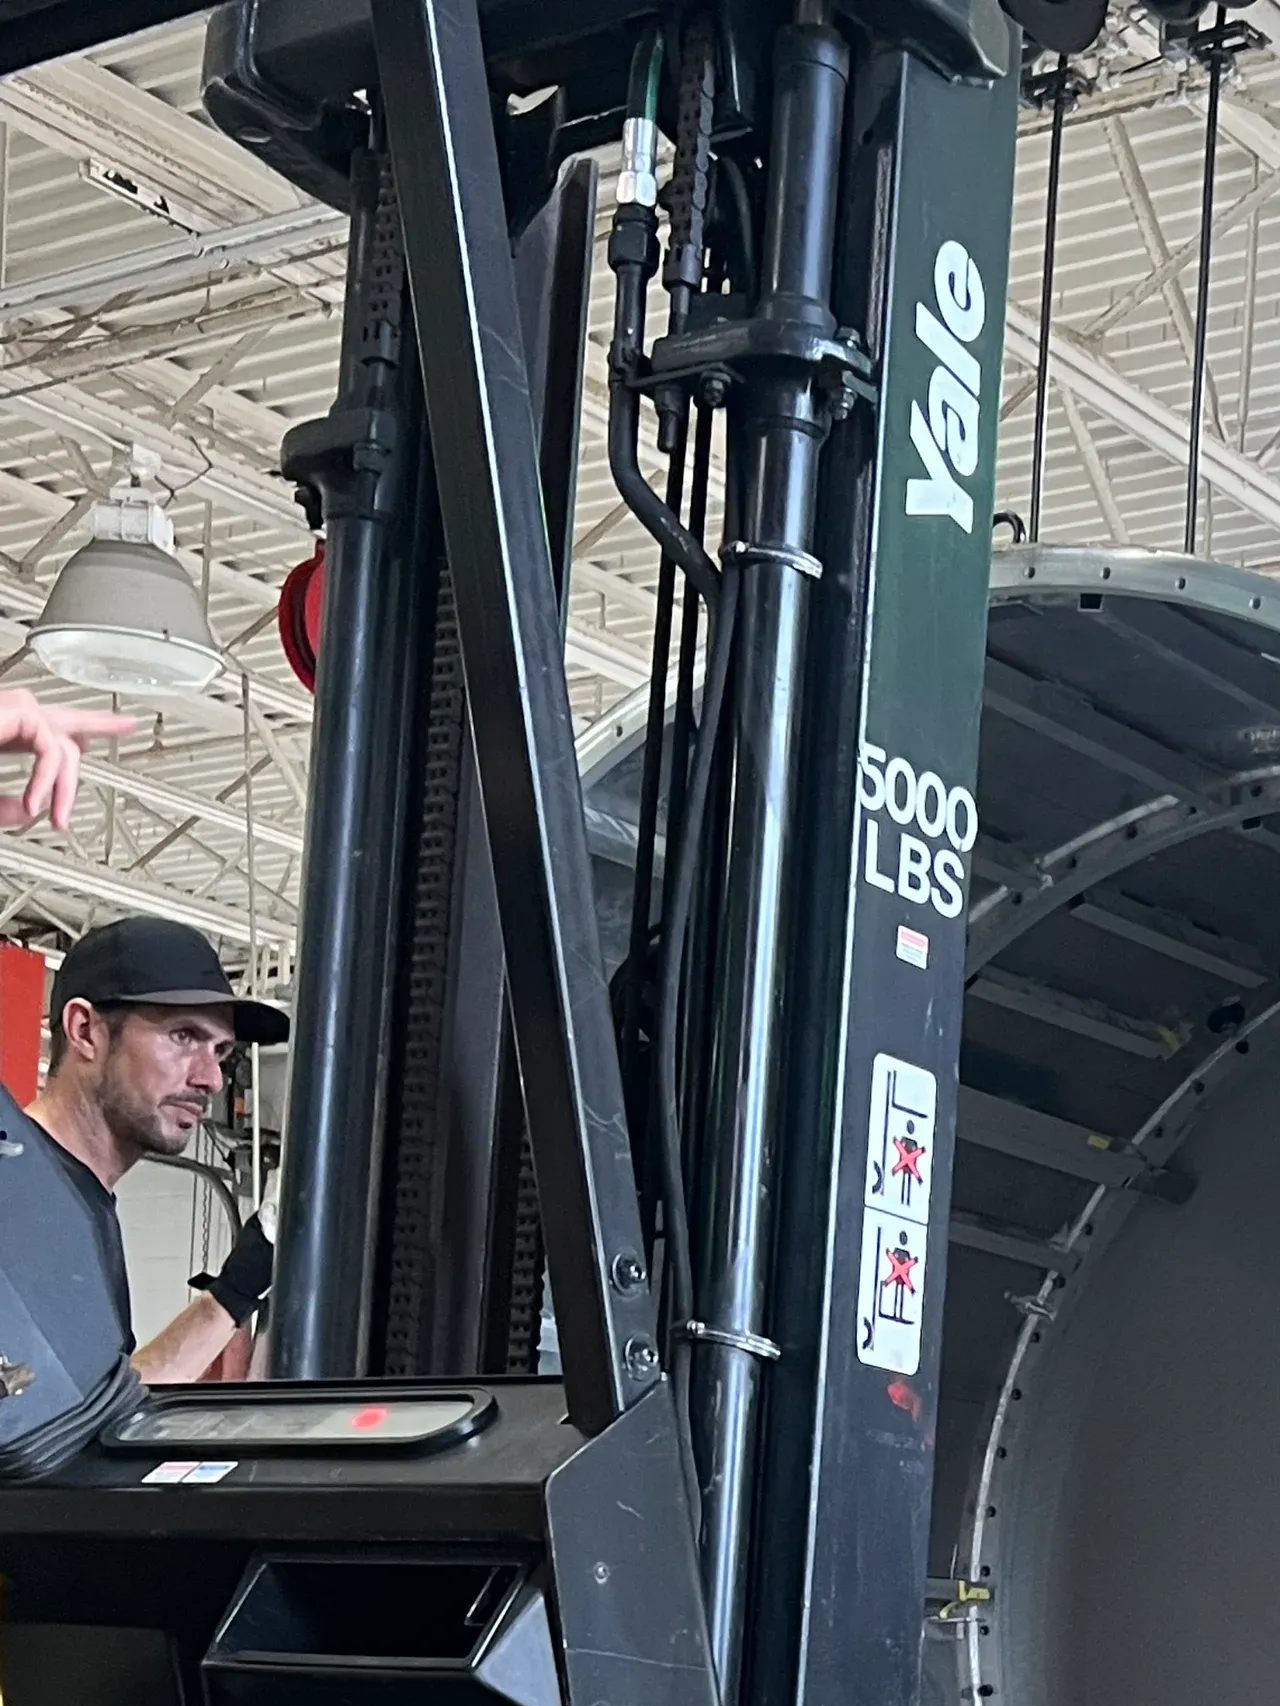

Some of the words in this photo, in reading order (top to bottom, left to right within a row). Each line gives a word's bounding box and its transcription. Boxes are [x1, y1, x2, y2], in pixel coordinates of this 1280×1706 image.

[906, 240, 985, 534] Yale
[859, 742, 978, 853] 5000
[864, 818, 965, 919] LBS
